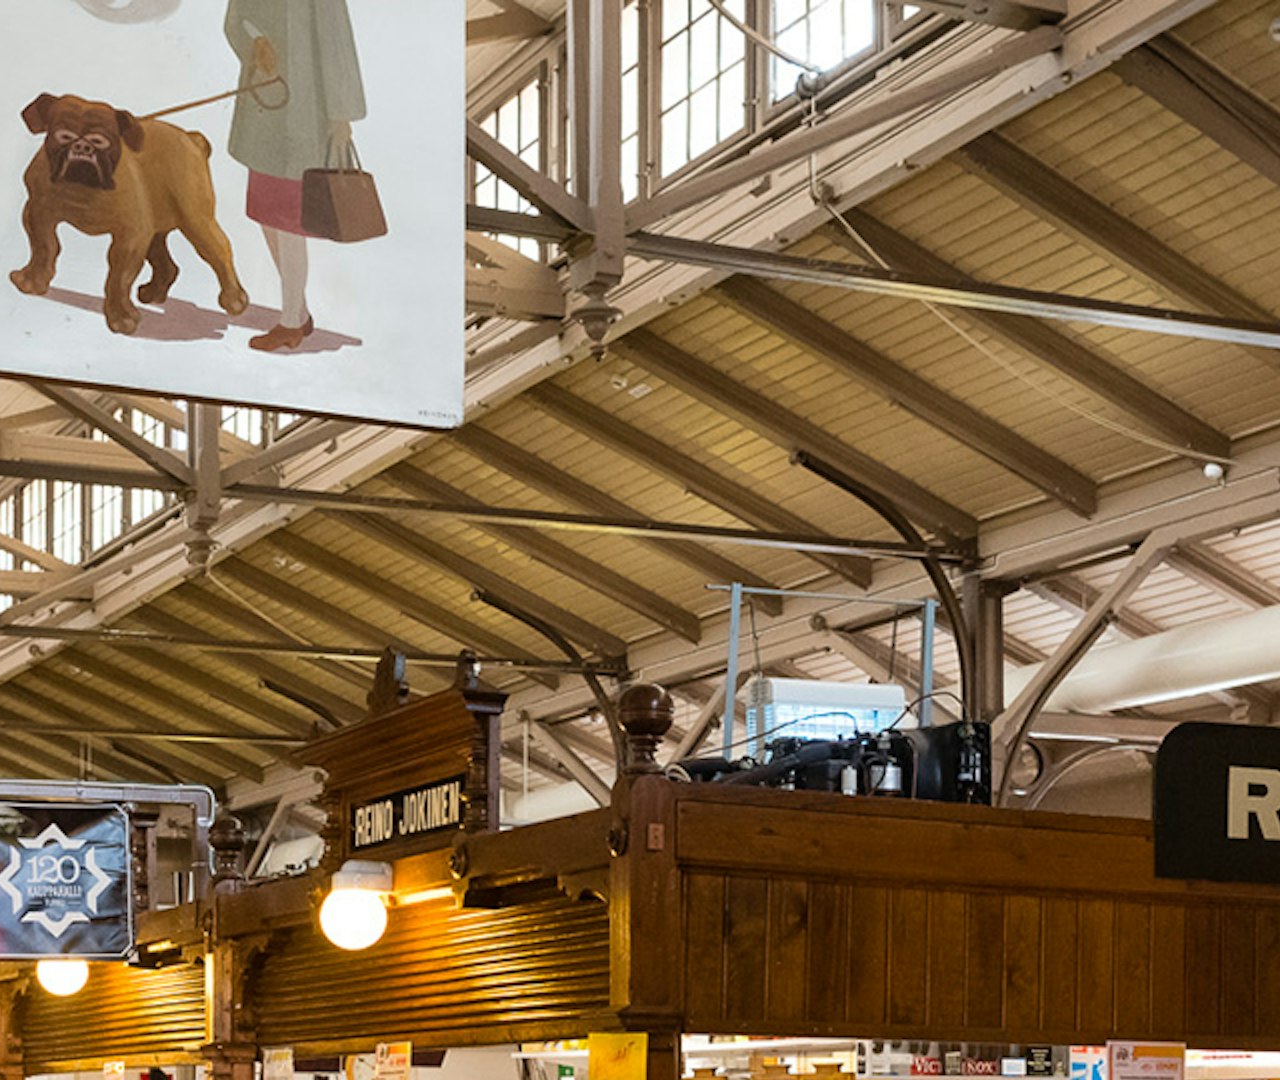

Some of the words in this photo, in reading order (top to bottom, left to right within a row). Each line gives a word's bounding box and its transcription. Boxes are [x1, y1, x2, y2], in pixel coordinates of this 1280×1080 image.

[355, 799, 394, 848] REINO
[398, 781, 461, 836] JOKINEN
[26, 854, 81, 884] 120
